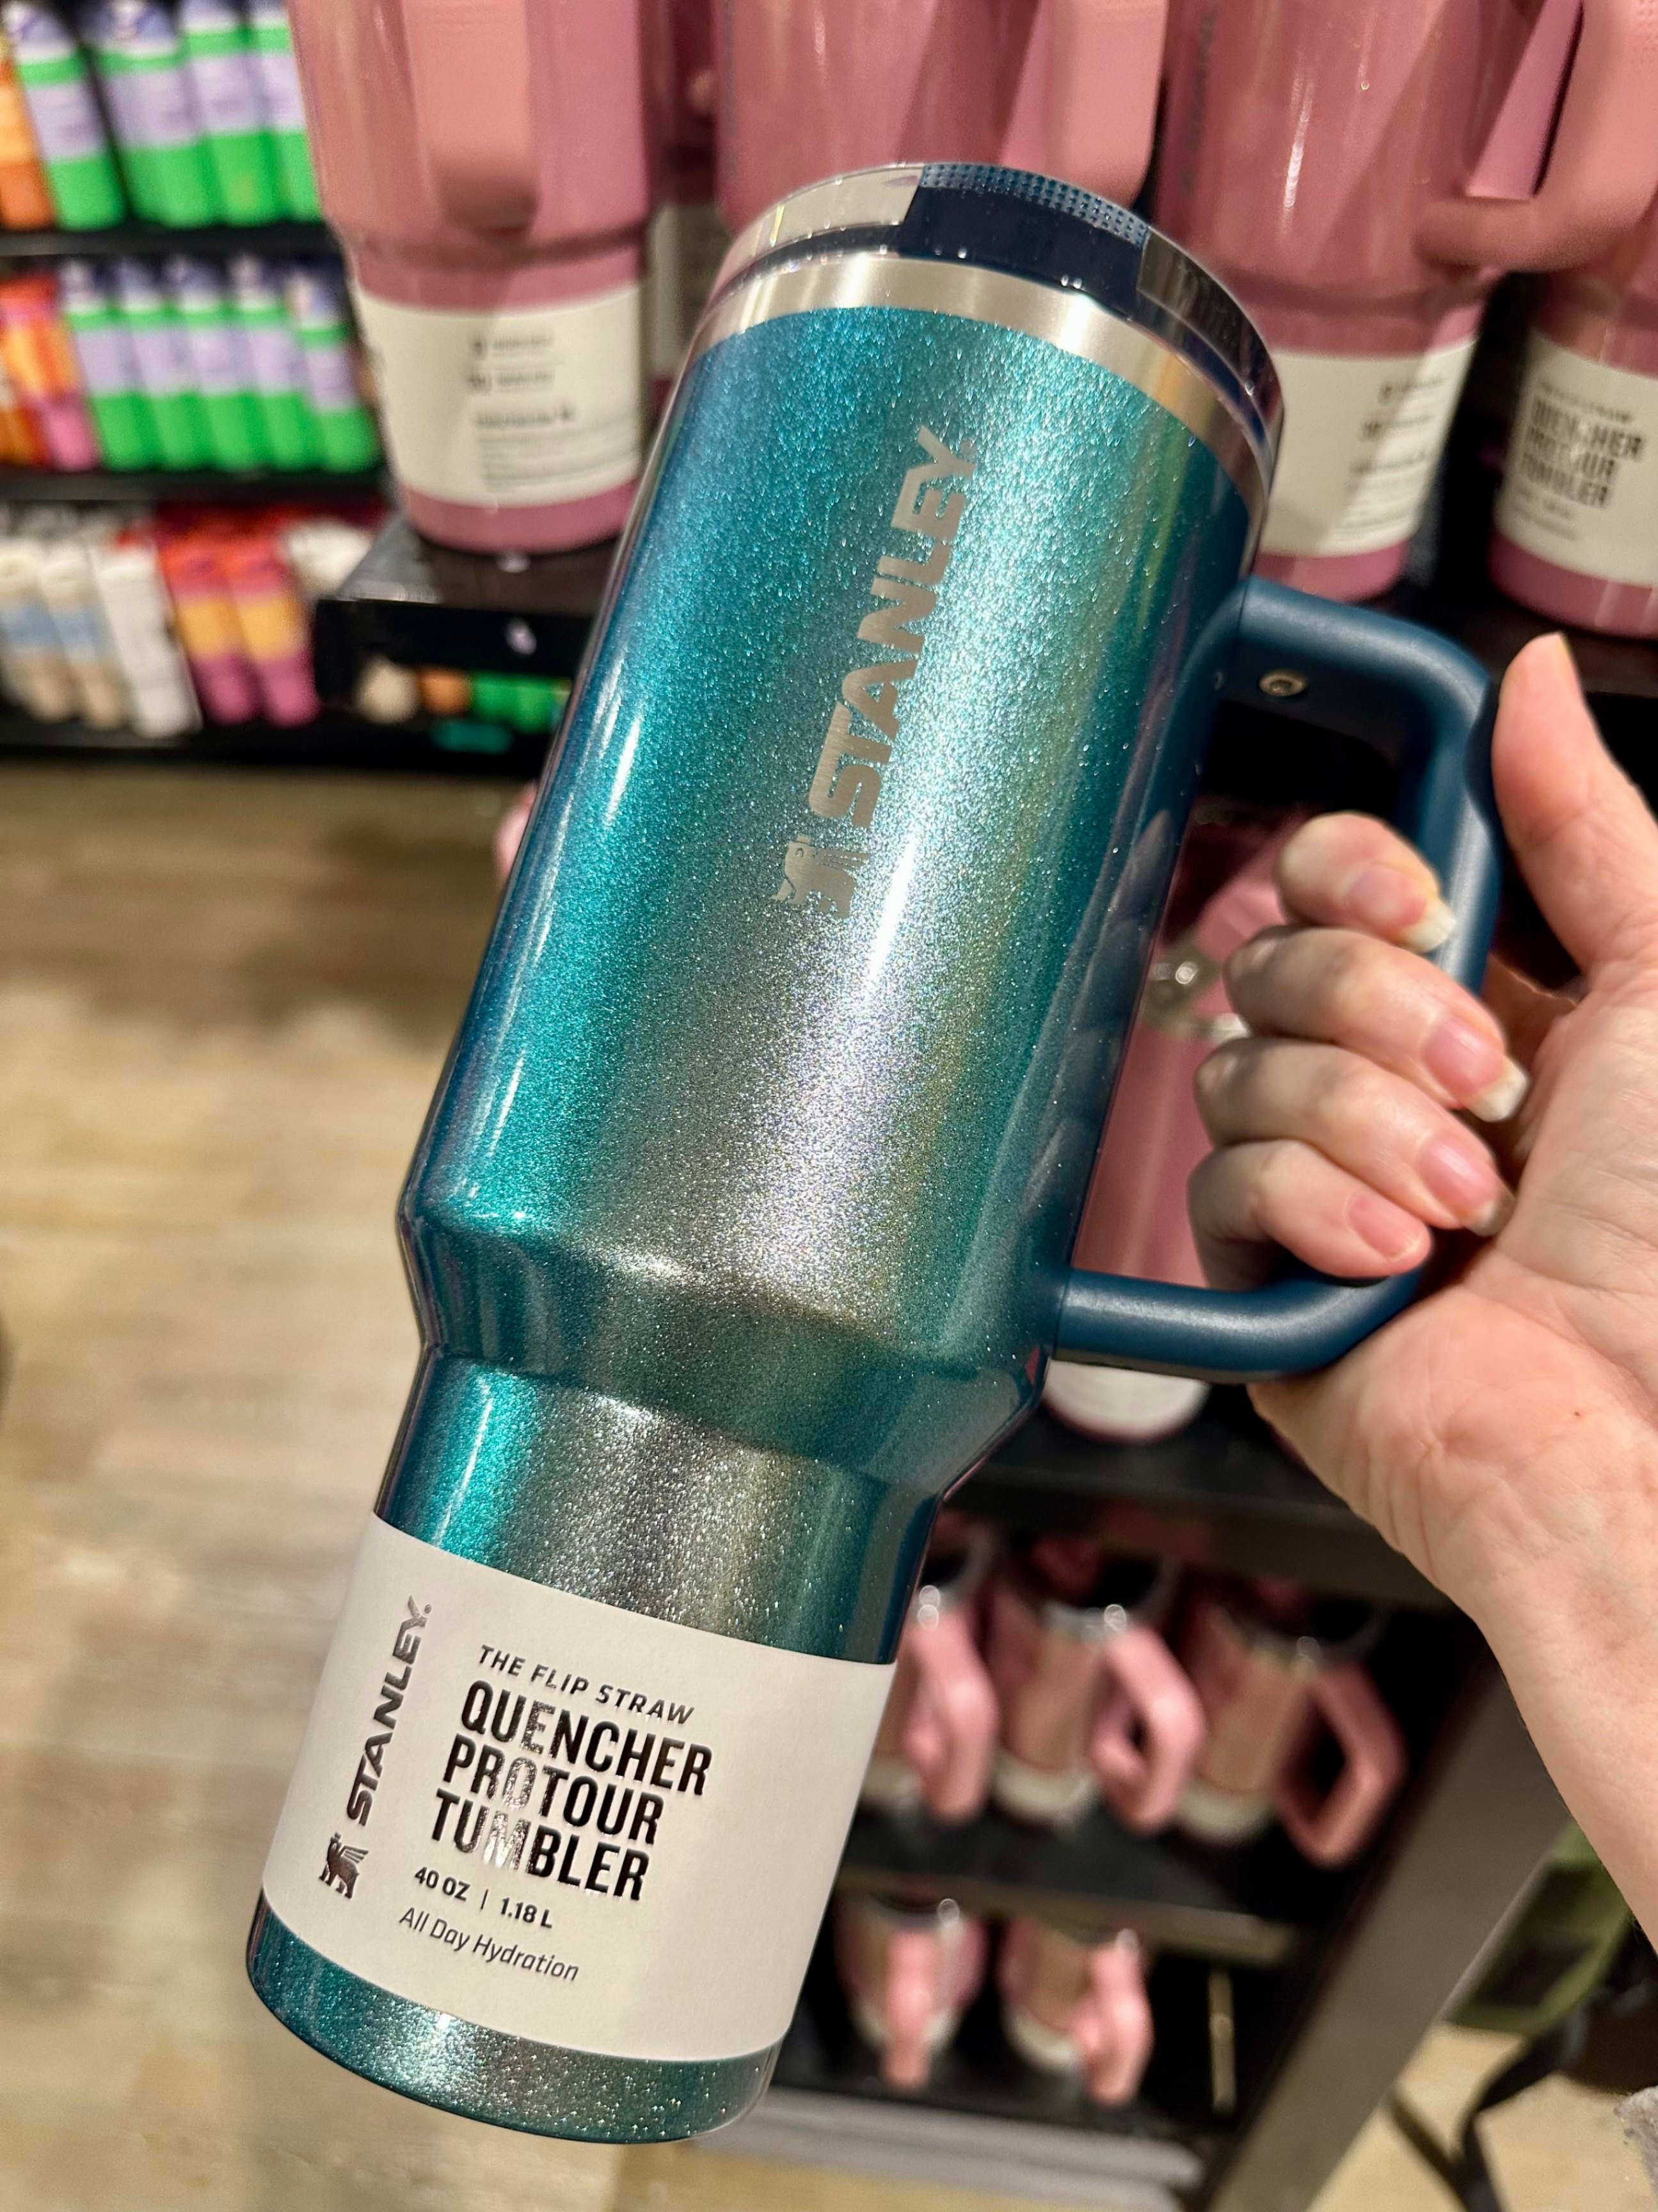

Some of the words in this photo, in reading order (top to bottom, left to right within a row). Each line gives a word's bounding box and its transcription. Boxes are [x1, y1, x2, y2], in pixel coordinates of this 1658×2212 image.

[808, 424, 976, 828] STANLEY
[461, 1679, 713, 1796] QUENCHER
[478, 1644, 525, 1676] THE
[530, 1663, 589, 1695] FLIP
[596, 1683, 695, 1725] STRAW
[431, 1788, 650, 1901] TUMBLER
[442, 1733, 664, 1845] PROTOUR
[399, 1907, 430, 1932] All
[430, 1918, 470, 1952] Day
[472, 1934, 579, 1981] Hydration
[415, 1866, 440, 1889] 40
[442, 1877, 471, 1902] OZ
[500, 1897, 538, 1923] 1.18
[540, 1909, 553, 1928] L
